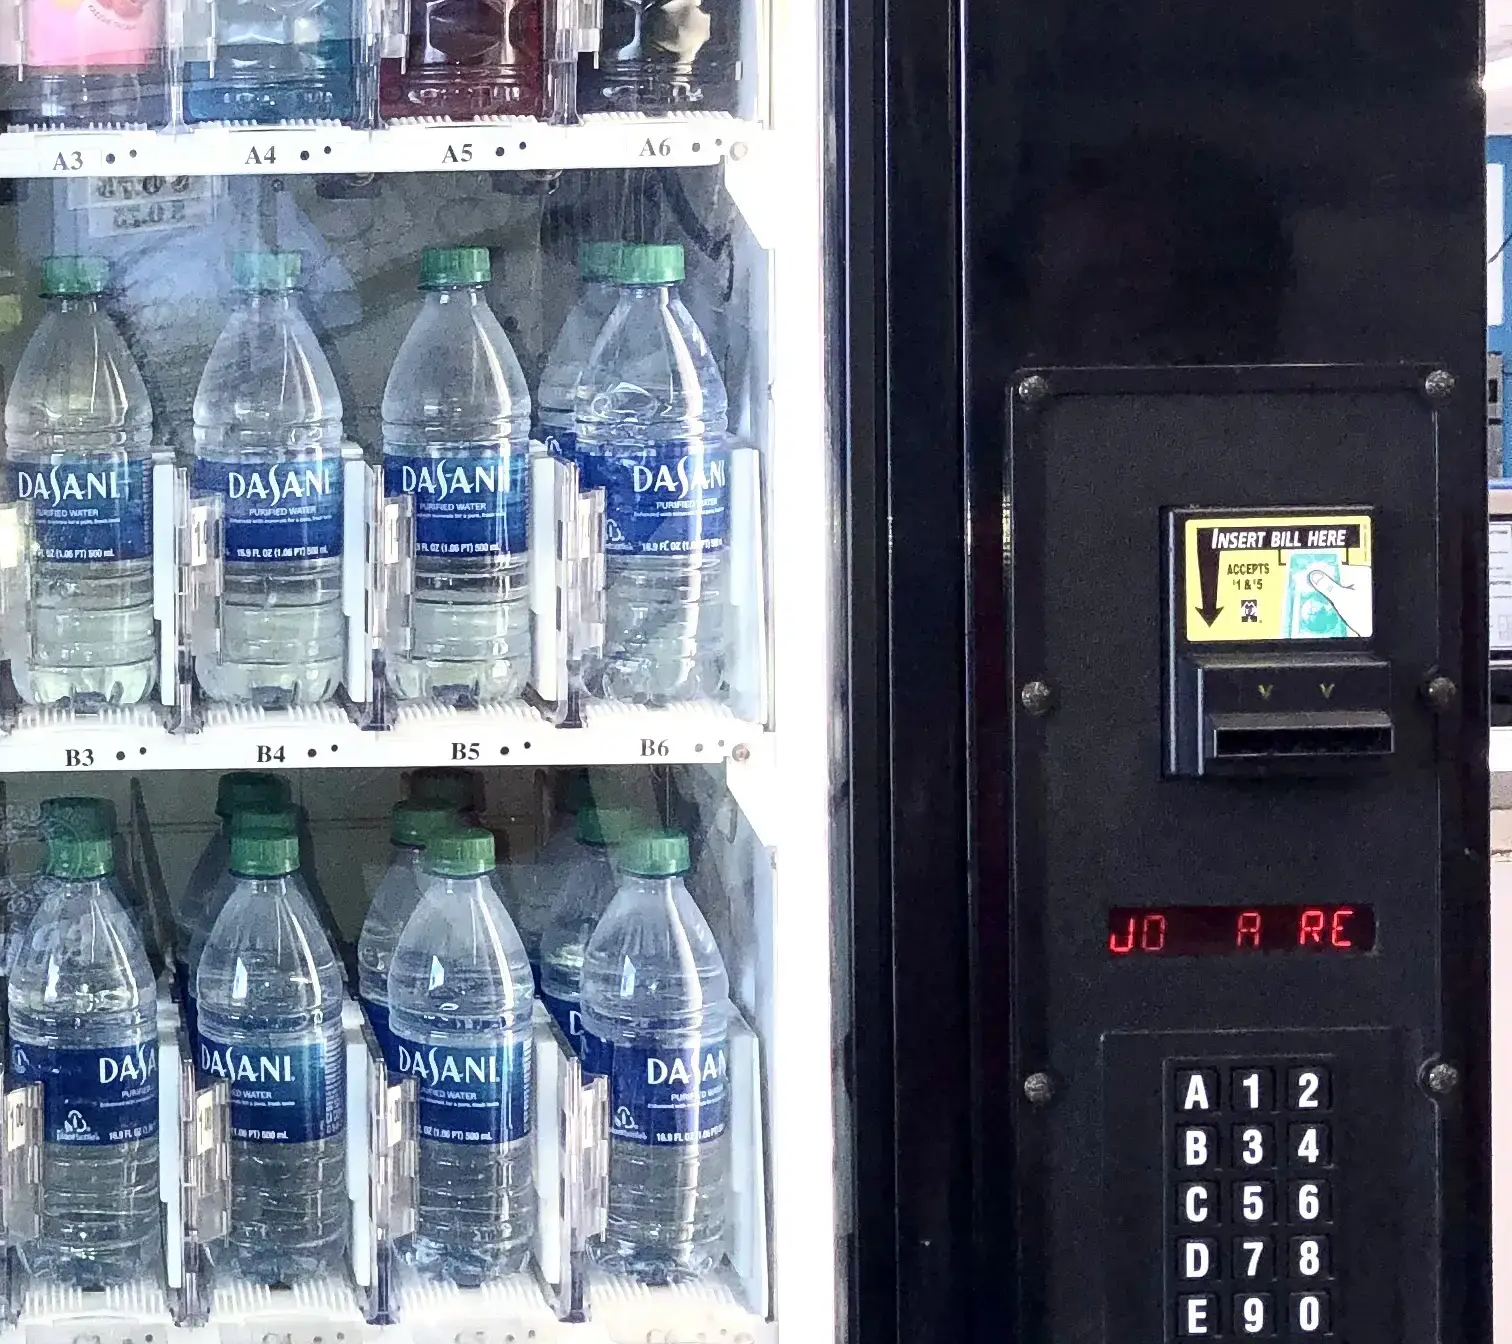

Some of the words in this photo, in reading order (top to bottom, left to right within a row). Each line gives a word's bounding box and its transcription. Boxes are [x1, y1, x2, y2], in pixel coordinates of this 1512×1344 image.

[245, 144, 276, 165] A4
[442, 143, 473, 163] A5
[639, 136, 670, 156] A6
[52, 150, 84, 171] A3
[18, 464, 121, 507] DASANI
[228, 463, 331, 507] DASANI
[402, 458, 505, 502] DASANI
[633, 455, 726, 500] DASANI
[69, 508, 99, 517] WATER
[456, 502, 487, 511] WATER
[1211, 528, 1266, 549] INSERT
[1270, 531, 1300, 547] BILL
[1307, 529, 1347, 547] HERE
[1227, 563, 1270, 575] ACCEPTS
[256, 745, 286, 763] B4
[451, 743, 481, 761] B5
[640, 738, 670, 756] B6
[65, 749, 95, 767] B3
[1238, 912, 1262, 946] A
[201, 1043, 296, 1084] DASANI
[398, 1044, 501, 1086] DASANI
[243, 1090, 272, 1099] WATER
[447, 1091, 477, 1100] WATER
[1184, 1074, 1209, 1109] A
[1242, 1074, 1259, 1108] 1
[1298, 1072, 1320, 1108] 2
[1185, 1130, 1208, 1166] B
[1242, 1129, 1263, 1164] 3
[1297, 1128, 1319, 1163] 4
[1185, 1186, 1208, 1222] C
[1242, 1185, 1264, 1221] 5
[1298, 1184, 1320, 1219] 6
[1185, 1242, 1209, 1278] D
[1242, 1241, 1264, 1276] 7
[1299, 1240, 1320, 1276] 8
[1187, 1298, 1208, 1334] E
[1243, 1297, 1264, 1333] 9
[1299, 1296, 1320, 1331] 0
